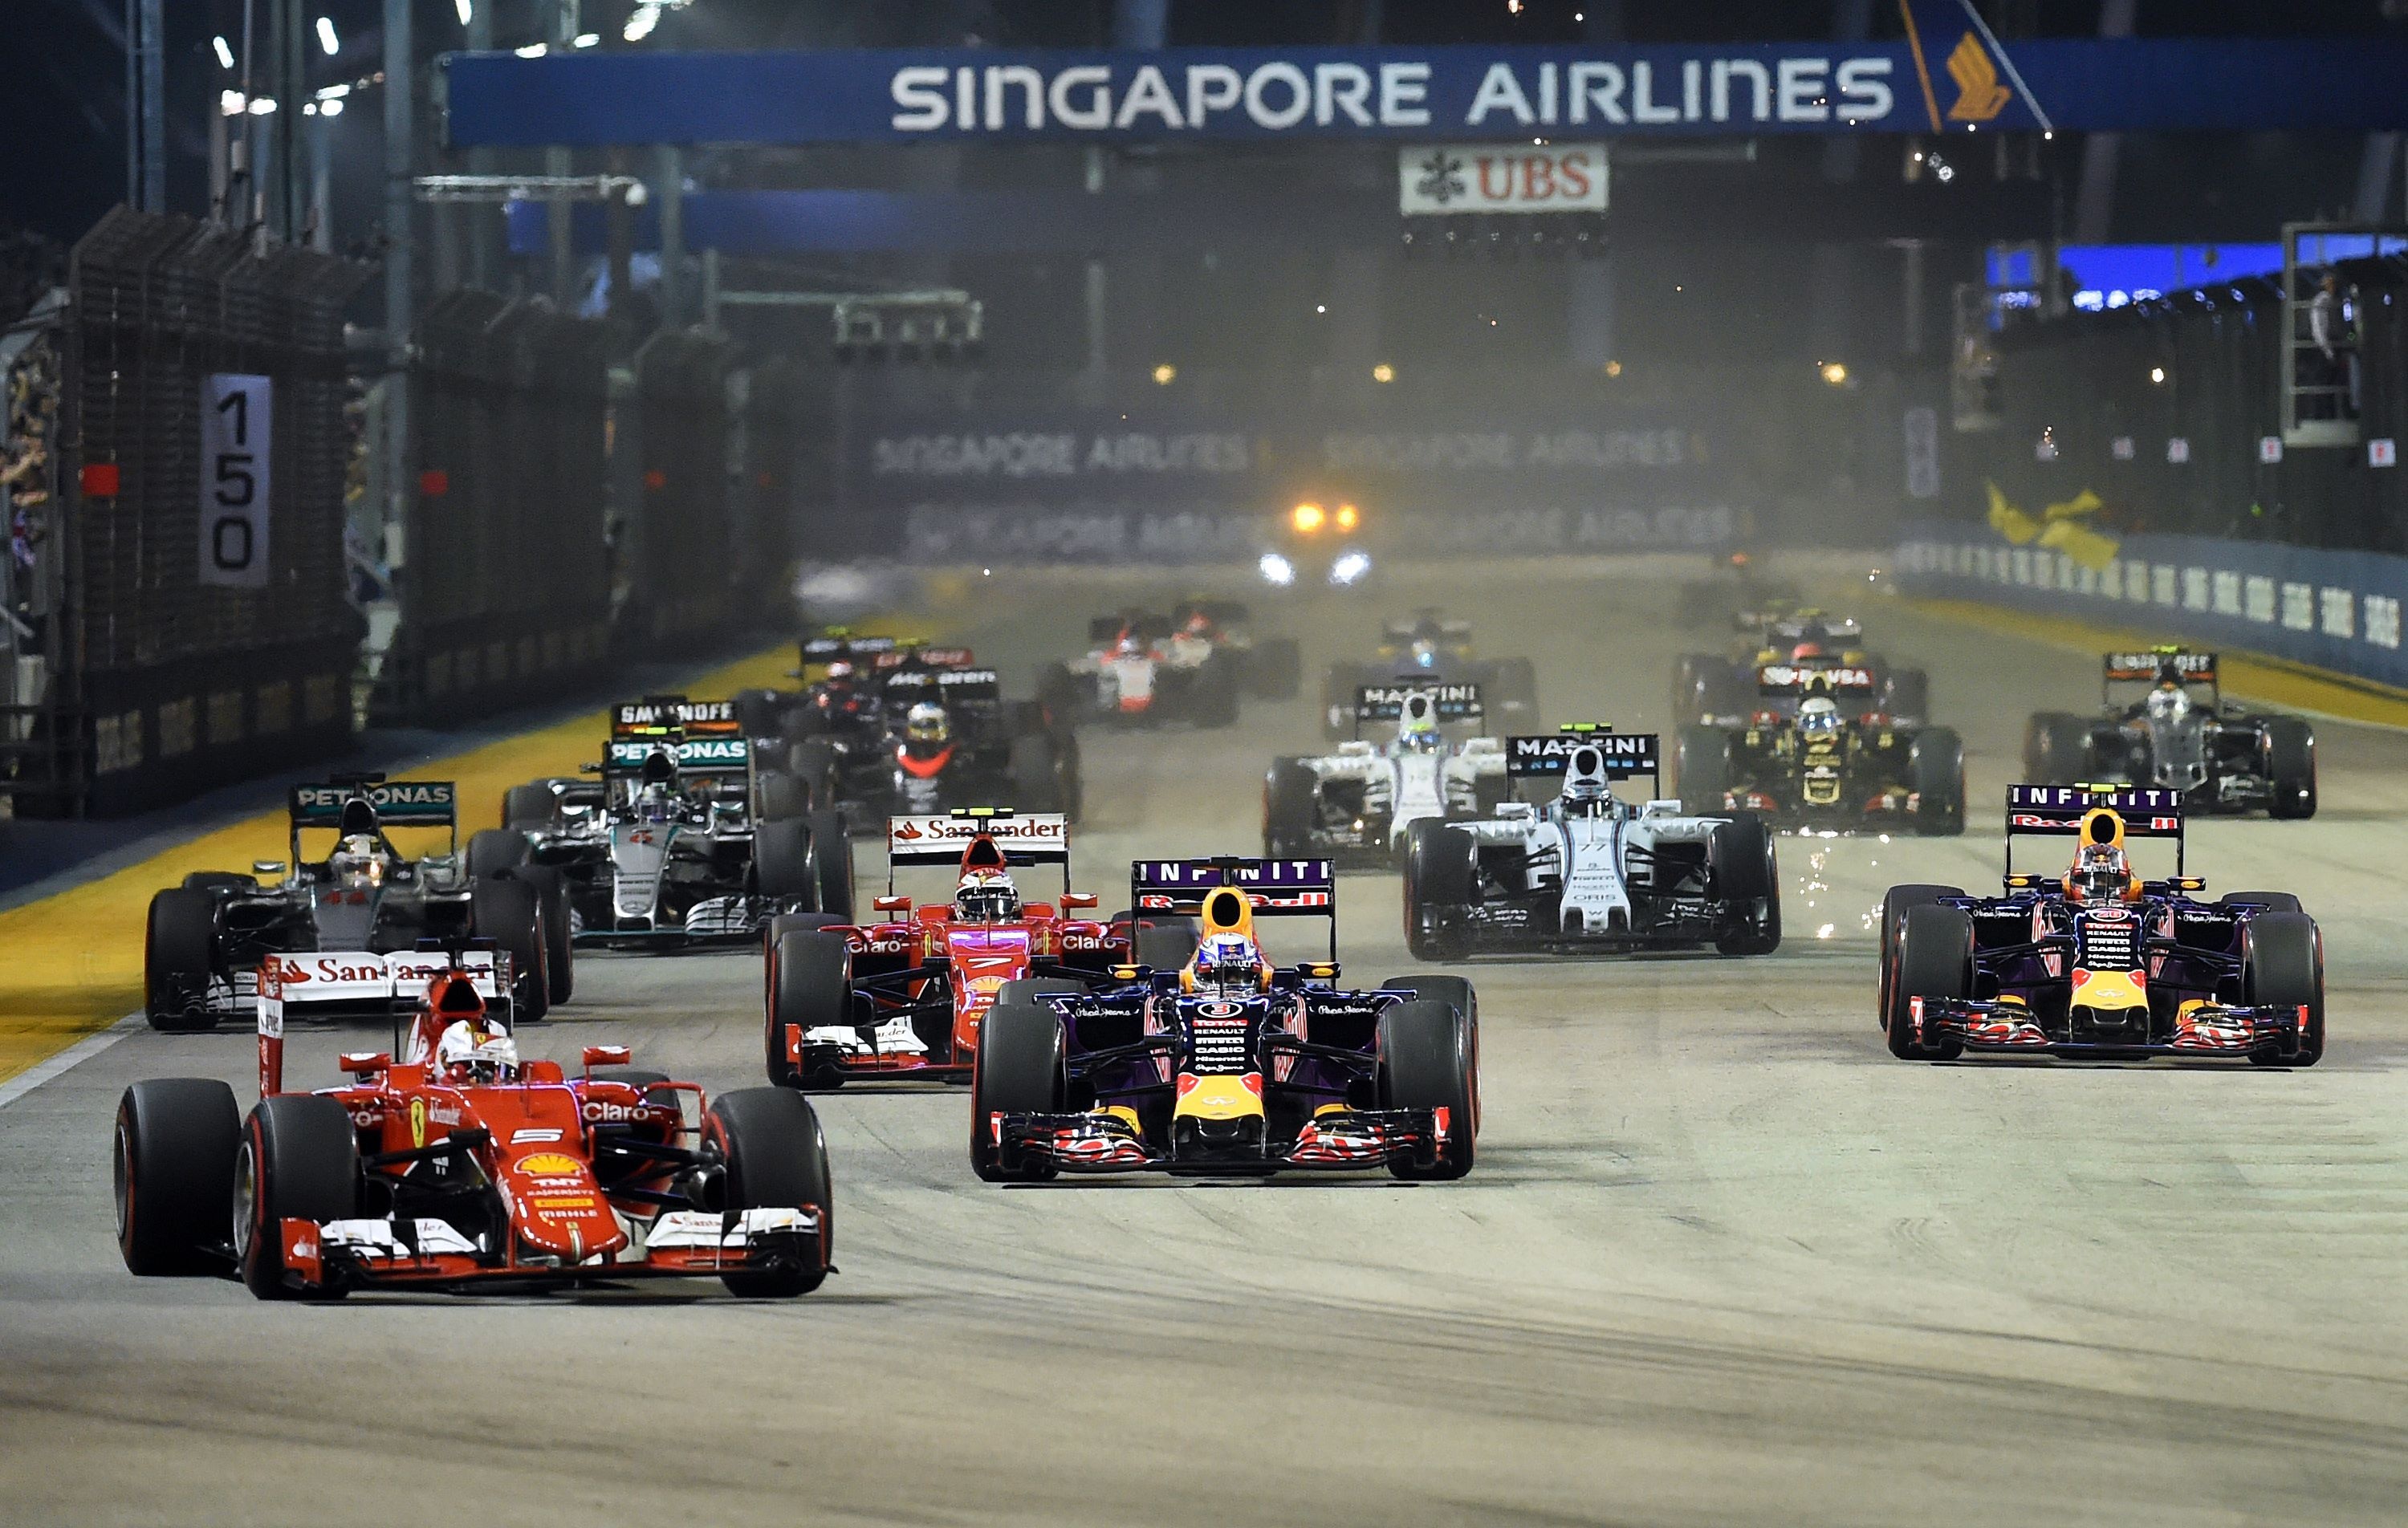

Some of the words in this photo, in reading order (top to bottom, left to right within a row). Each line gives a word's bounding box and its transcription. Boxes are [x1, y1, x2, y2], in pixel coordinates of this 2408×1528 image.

[890, 62, 1433, 131] SINGAPORE
[1466, 57, 1895, 126] AIRLINES
[1476, 155, 1592, 202] UBS
[212, 390, 255, 573] 150
[621, 703, 732, 723] SMNOFF
[612, 742, 746, 760] PETONAS
[298, 787, 450, 807] PETONAS
[928, 819, 1062, 839] Sanander
[1140, 861, 1328, 881] INFNITI
[318, 958, 490, 981] Sananr
[582, 1102, 649, 1122] Claro
[510, 1128, 564, 1145] 5
